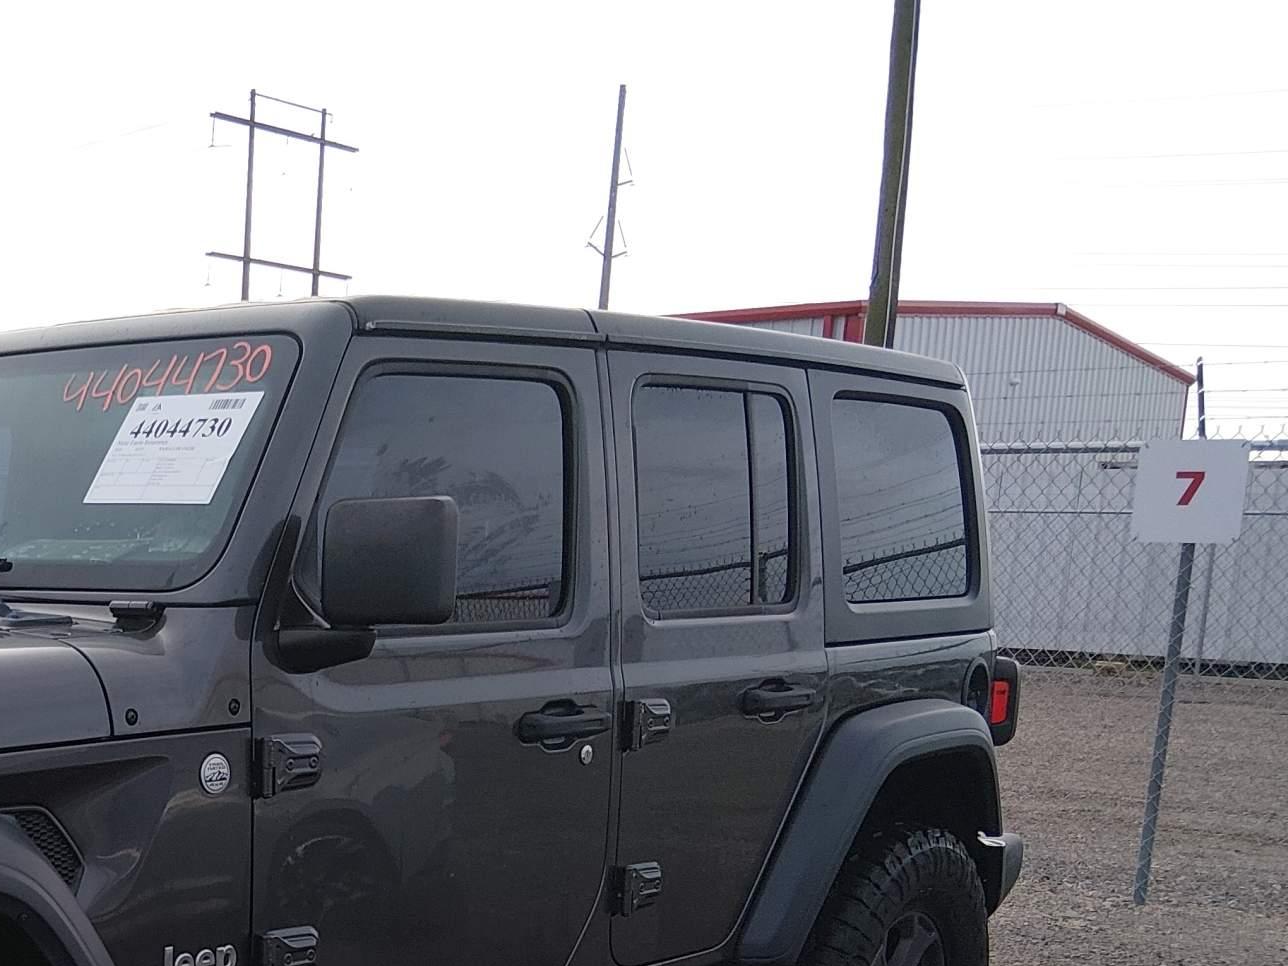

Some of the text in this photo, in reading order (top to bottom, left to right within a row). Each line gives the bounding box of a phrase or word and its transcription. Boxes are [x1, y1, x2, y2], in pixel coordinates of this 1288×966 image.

[63, 341, 273, 412] 44044730
[129, 416, 233, 439] 44044730
[1175, 471, 1206, 506] 7
